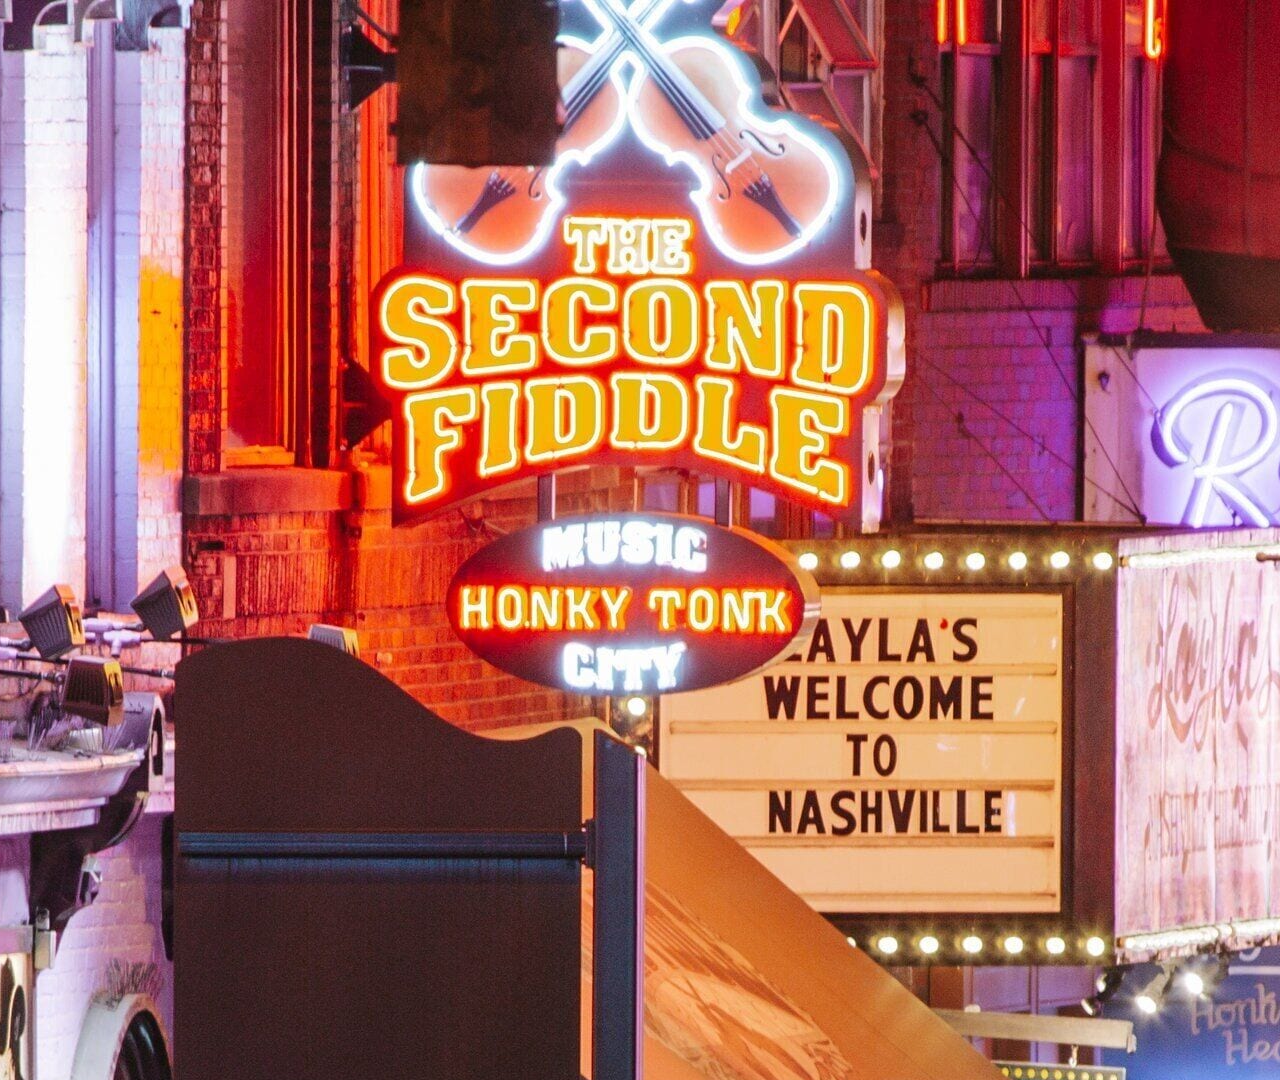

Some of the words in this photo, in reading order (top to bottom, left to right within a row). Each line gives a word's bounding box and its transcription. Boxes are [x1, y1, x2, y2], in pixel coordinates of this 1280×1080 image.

[562, 215, 693, 276] THE
[380, 277, 874, 395] SECOND
[404, 373, 846, 504] FIDDLE
[543, 522, 708, 573] MUSIC
[459, 586, 632, 631] HONKY
[649, 586, 792, 632] TONK
[562, 641, 686, 690] CITY
[764, 676, 995, 721] WELCOME
[846, 734, 898, 777] TO
[768, 790, 1003, 835] NASHVILLE
